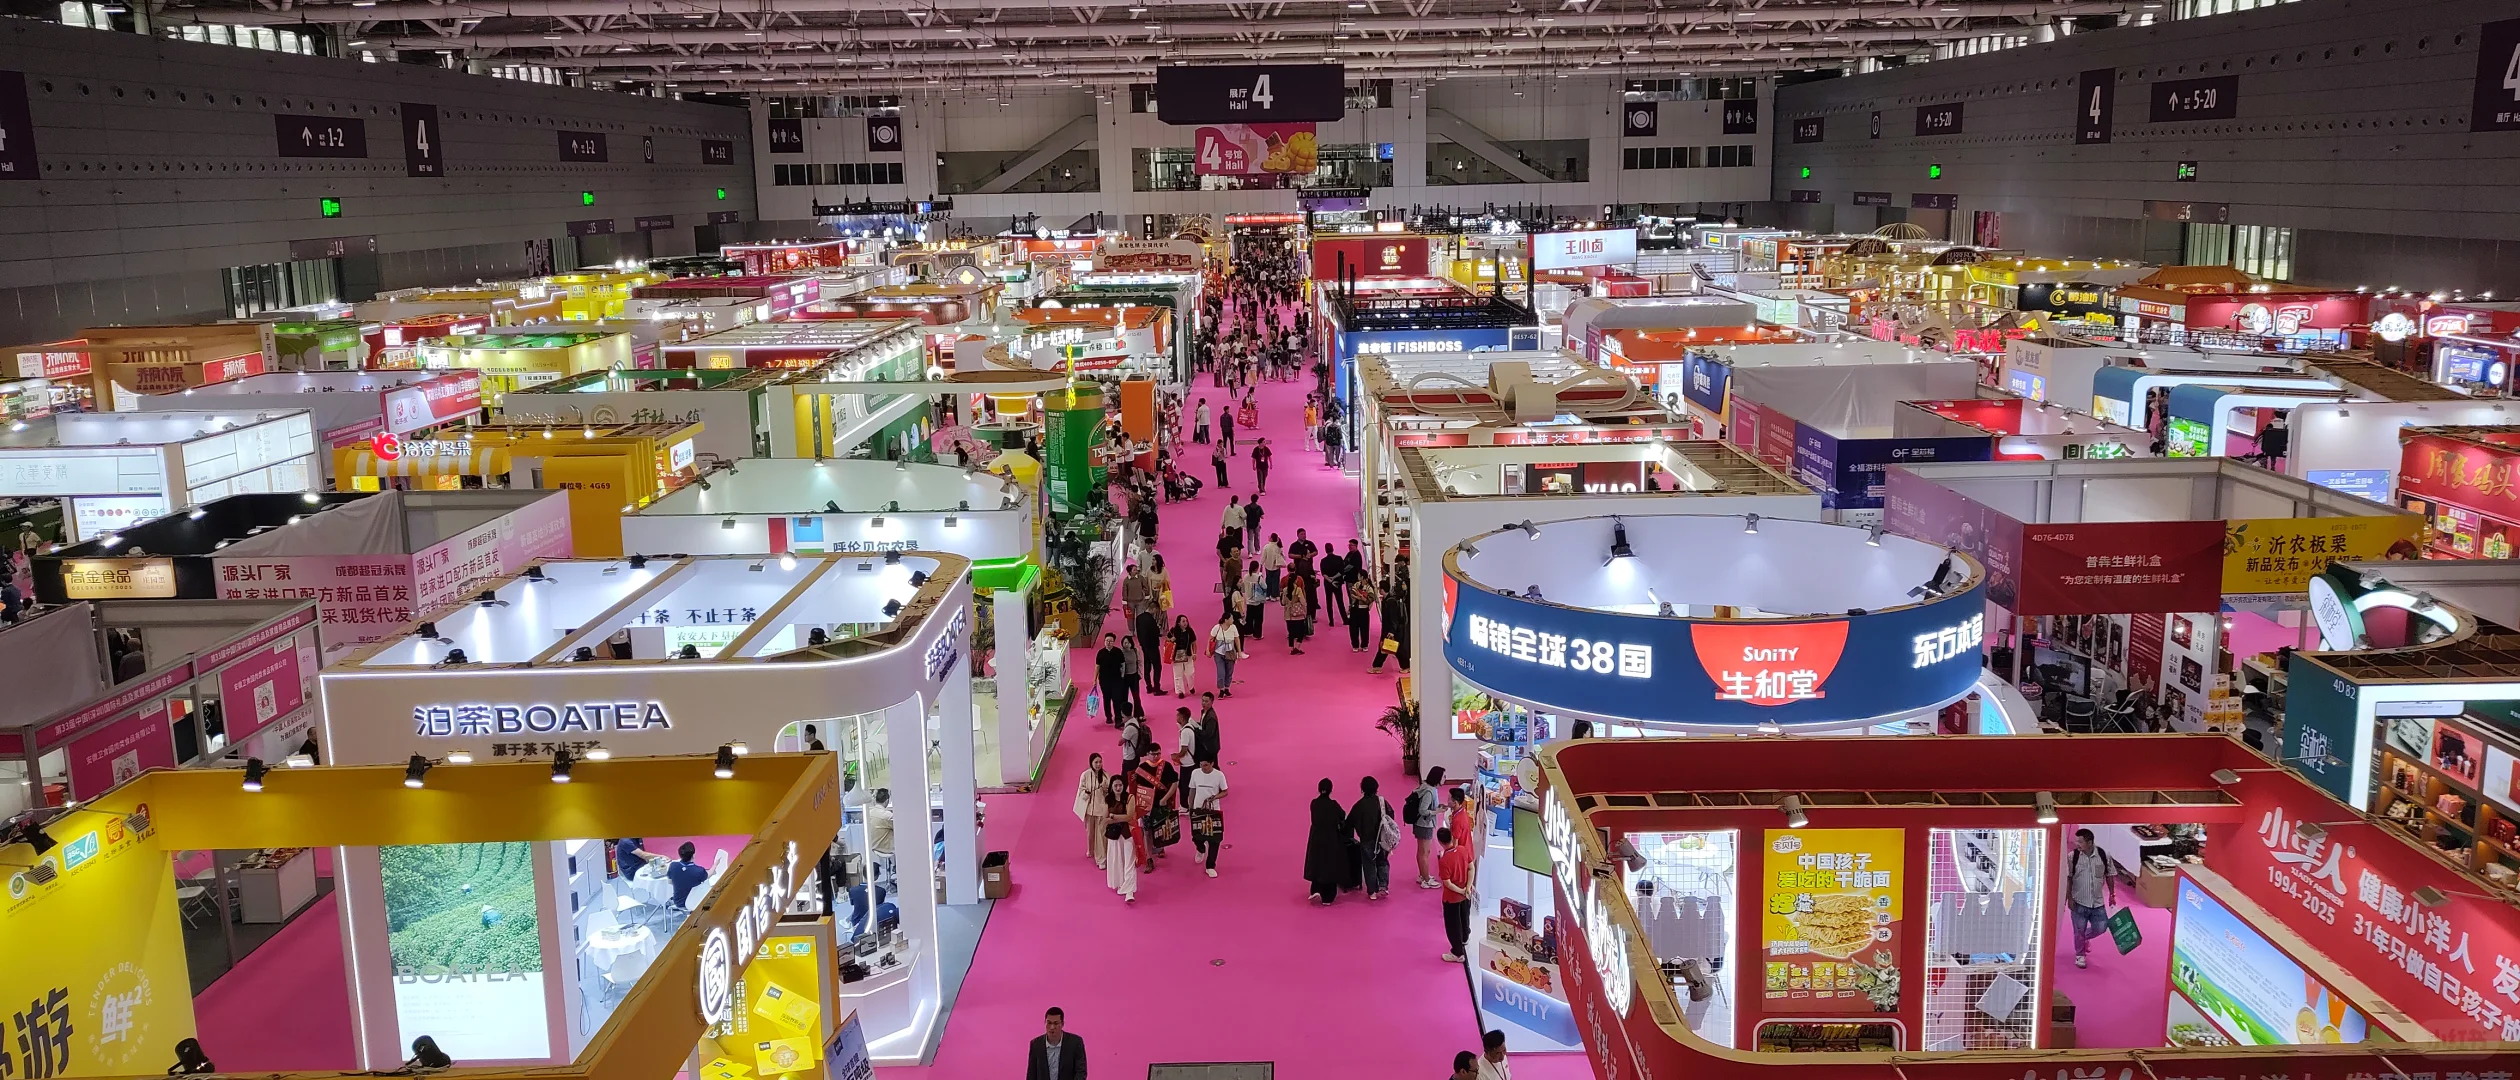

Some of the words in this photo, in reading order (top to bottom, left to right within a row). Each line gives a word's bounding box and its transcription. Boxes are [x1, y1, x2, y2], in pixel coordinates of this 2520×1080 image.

[1229, 88, 1248, 99] 展厅
[1252, 73, 1274, 110] 4
[2193, 88, 2217, 110] 5-20
[1229, 100, 1248, 110] Hall
[2090, 85, 2101, 125] 4
[327, 127, 345, 148] 1-2
[417, 119, 429, 158] 4
[1201, 136, 1222, 171] 4
[1224, 150, 1243, 160] 号馆
[1225, 160, 1244, 171] Hall
[1565, 238, 1604, 255] 王小卤
[1397, 341, 1463, 353] FISHBOSS
[403, 441, 472, 457] 洽洽坚果
[2031, 533, 2074, 542] 4D76-4D78
[2268, 533, 2347, 555] 沂农板栗
[2085, 554, 2162, 568] 普犇生鲜礼盒
[2246, 556, 2299, 573] 新品发布
[70, 568, 132, 584] 高金食品
[222, 564, 292, 582] 源头厂家
[1469, 613, 1653, 680] 畅销全球38国
[1722, 668, 1818, 700] 生和堂
[1797, 852, 1872, 871] 中国孩子
[1777, 870, 1890, 889] 爱吃的干脆面
[2268, 865, 2336, 925] 1994-2025
[2358, 867, 2476, 975] 健康小洋人
[396, 962, 528, 985] BOATEA
